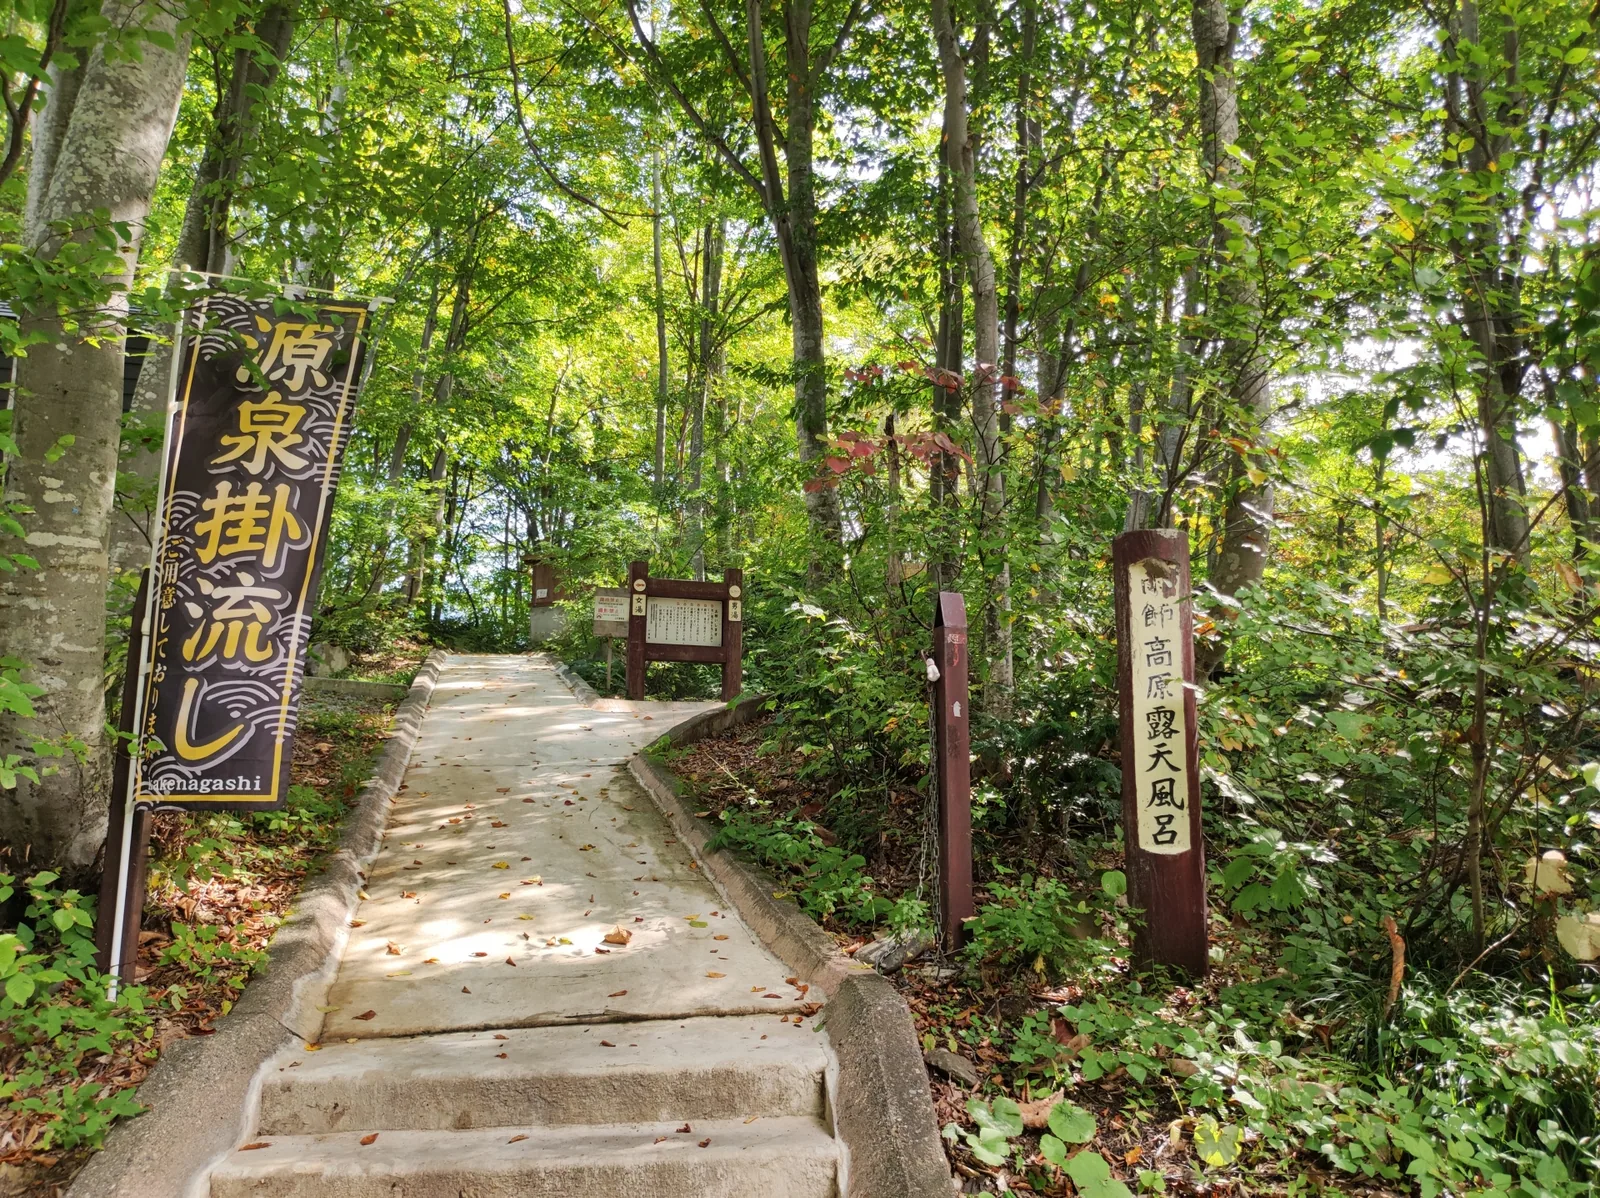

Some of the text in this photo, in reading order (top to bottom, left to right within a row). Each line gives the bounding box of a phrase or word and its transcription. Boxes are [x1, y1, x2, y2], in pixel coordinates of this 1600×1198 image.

[175, 314, 335, 761] 源泉掛流し
[634, 596, 644, 614] 女湯
[730, 602, 739, 620] 男湯
[148, 775, 261, 794] kakenagashi
